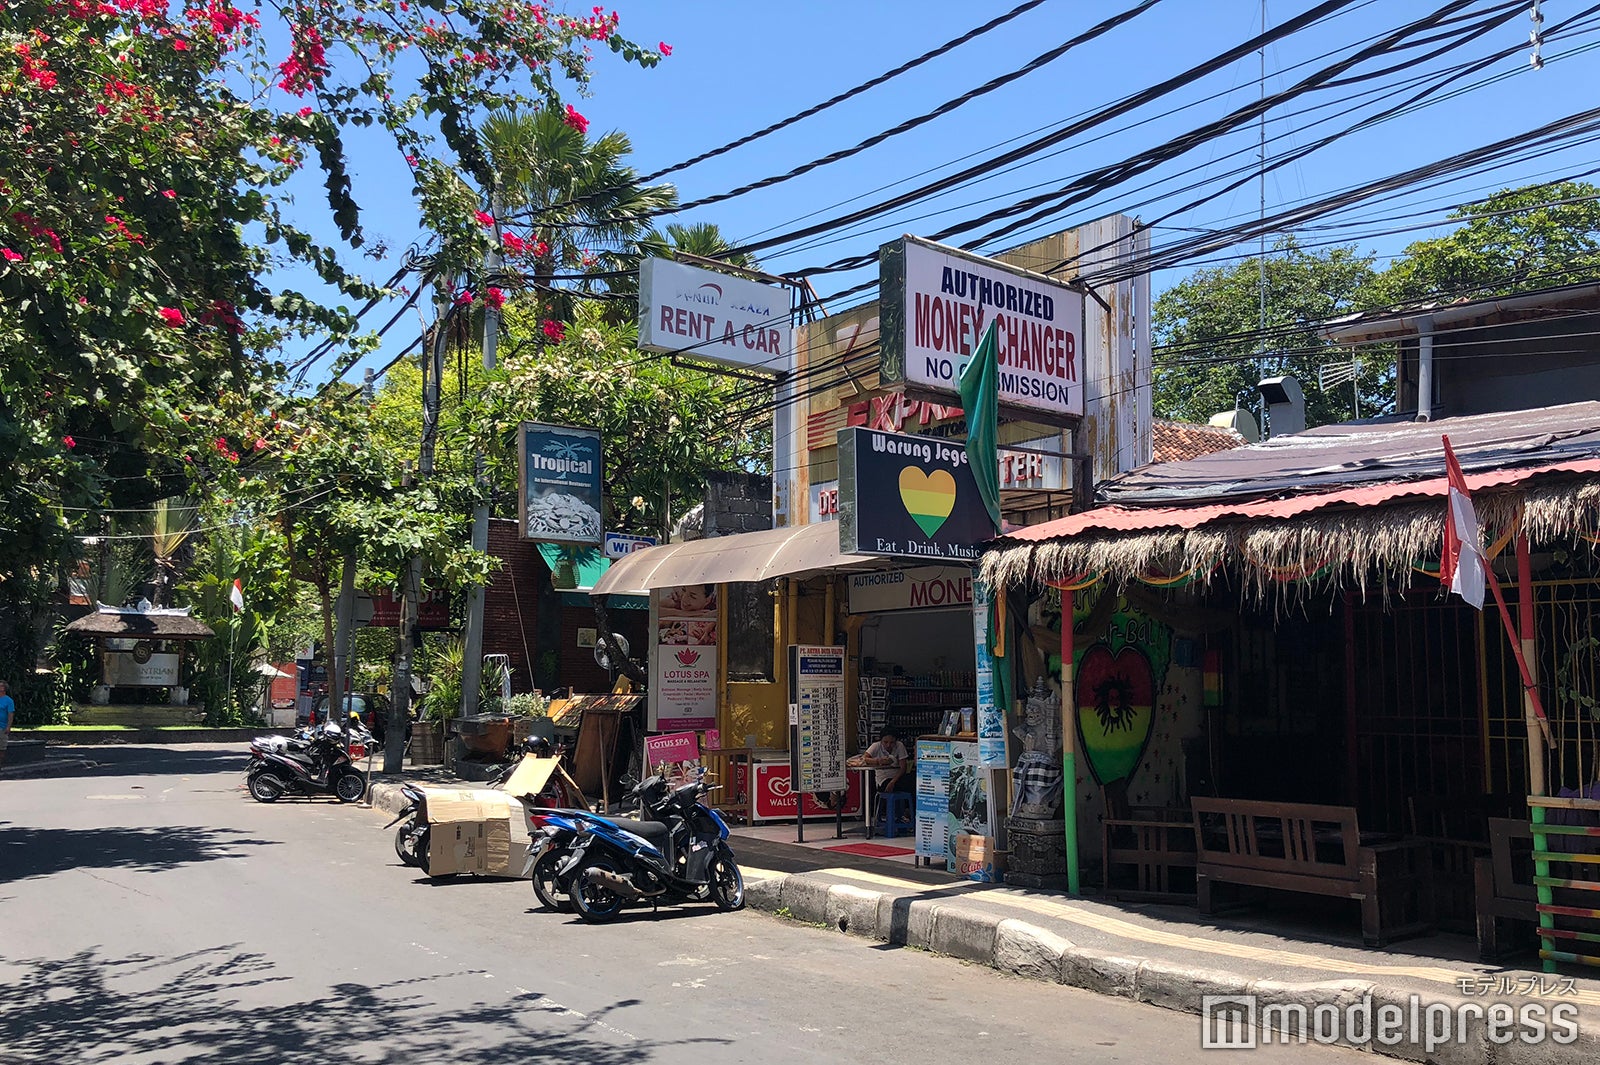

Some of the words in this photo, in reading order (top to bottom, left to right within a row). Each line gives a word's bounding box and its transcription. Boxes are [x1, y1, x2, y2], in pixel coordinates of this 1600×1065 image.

[941, 266, 1054, 321] AUTHORIZED
[660, 305, 715, 341] RENT
[722, 321, 736, 346] A
[743, 324, 781, 355] CAR
[915, 292, 985, 356] MONEY
[996, 313, 1076, 382] CHANGER
[926, 357, 953, 380] NO
[872, 434, 931, 463] Warung
[532, 453, 592, 474] Tropical
[613, 542, 628, 553] Wi
[876, 538, 897, 552] Eat
[908, 540, 945, 557] Drink,
[948, 543, 981, 558] Music
[853, 572, 904, 588] AUTHORIZED
[649, 740, 674, 749] LOTUS
[675, 738, 690, 746] SPA
[769, 798, 798, 807] WALL'S
